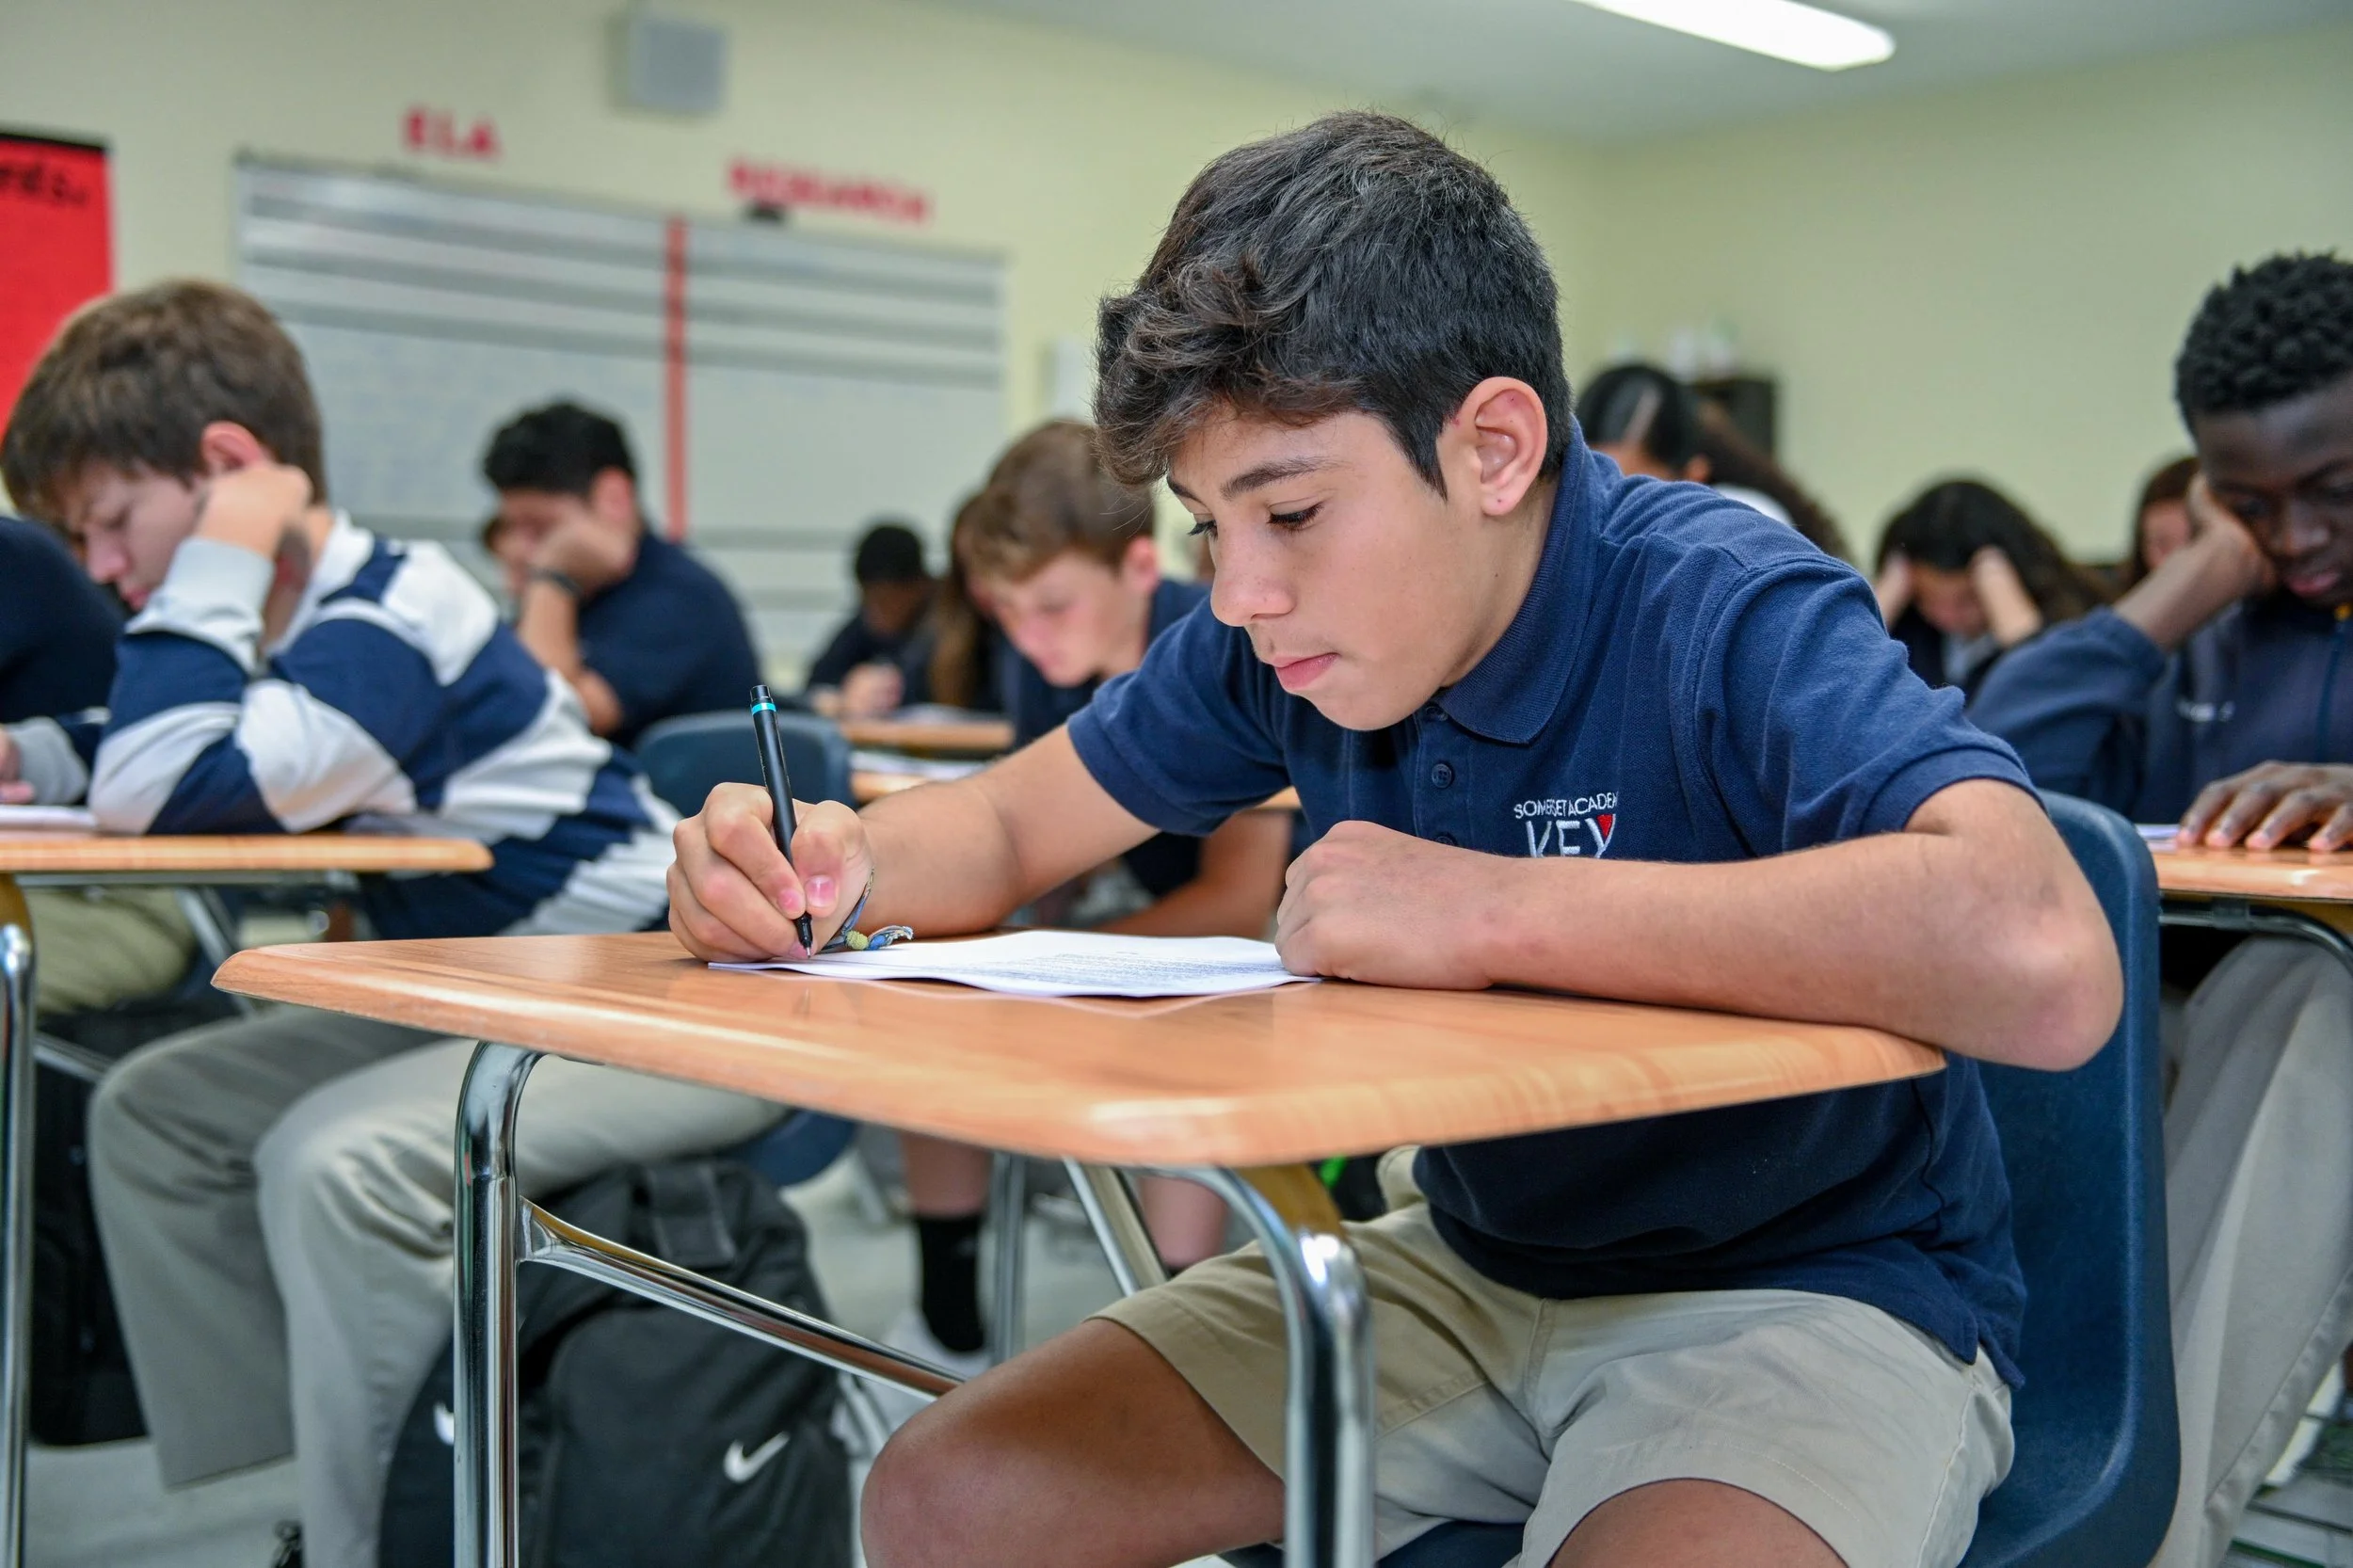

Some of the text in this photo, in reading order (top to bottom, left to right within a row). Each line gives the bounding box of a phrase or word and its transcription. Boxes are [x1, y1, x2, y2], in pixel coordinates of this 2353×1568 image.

[404, 107, 498, 160] ELA
[1568, 791, 1619, 817] ACADEM
[1526, 813, 1617, 858] KEY
